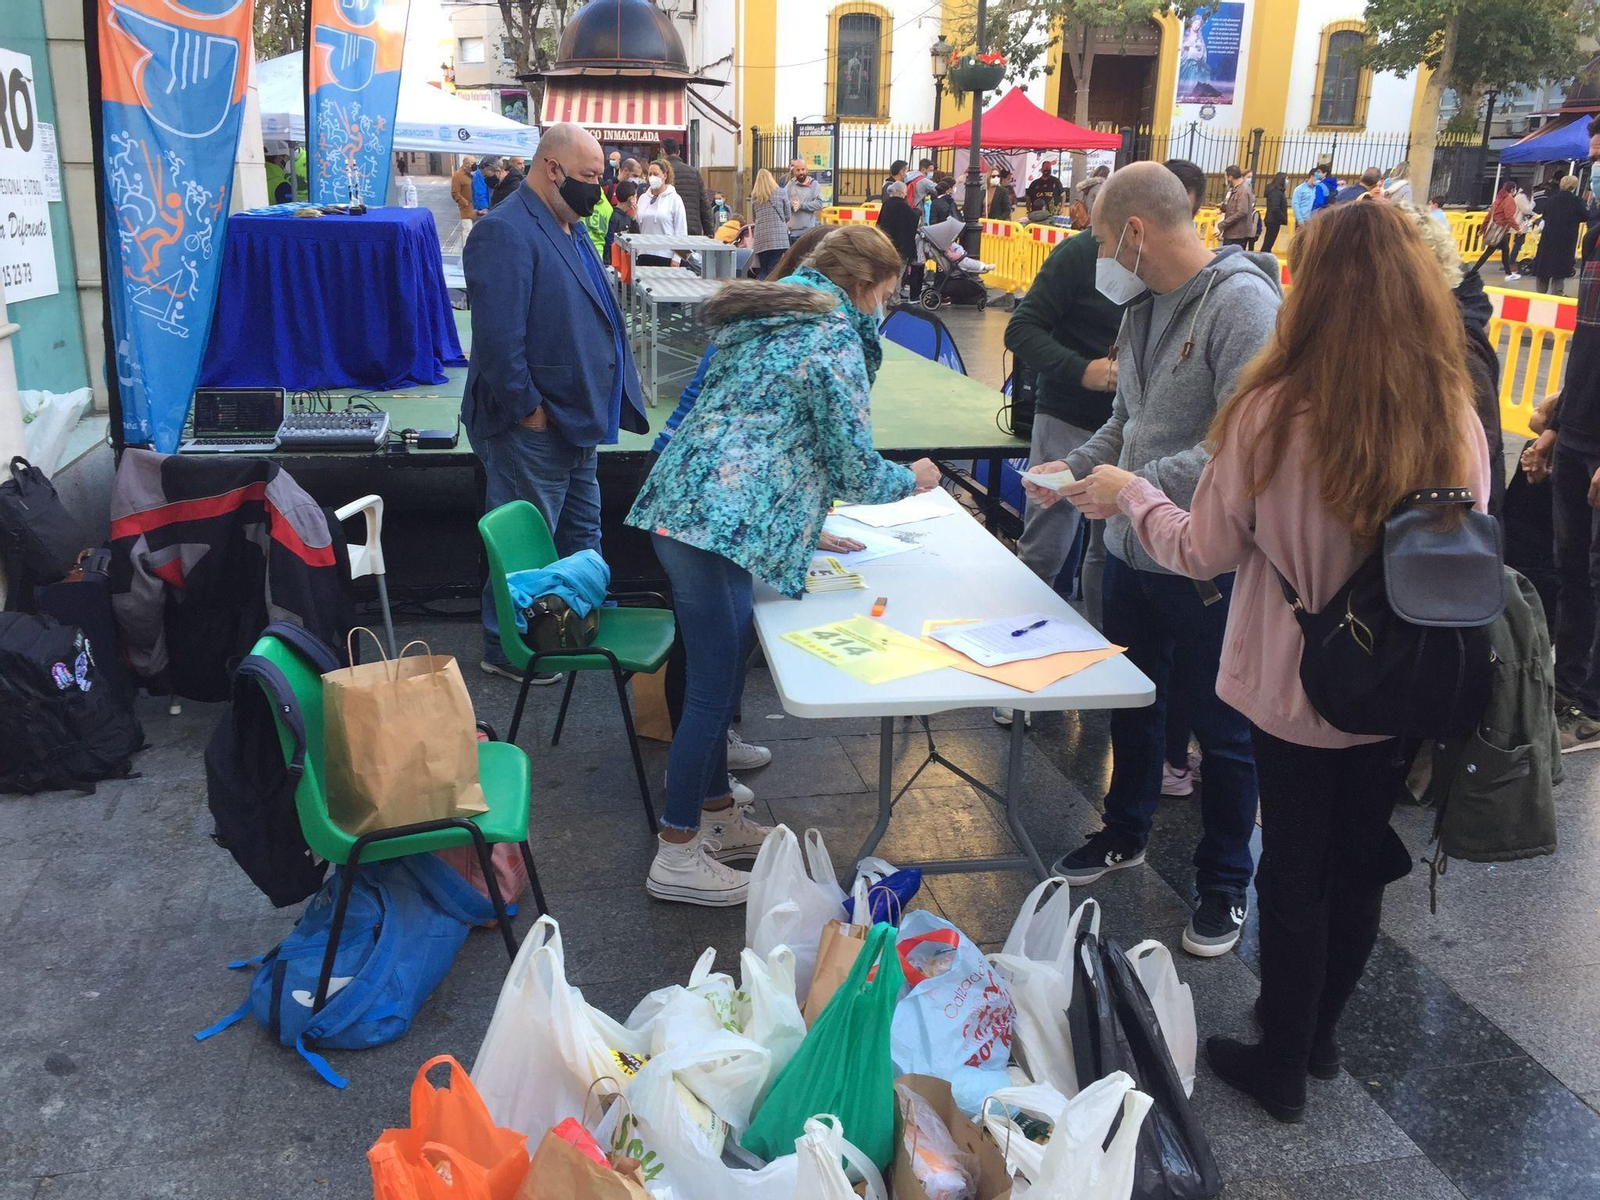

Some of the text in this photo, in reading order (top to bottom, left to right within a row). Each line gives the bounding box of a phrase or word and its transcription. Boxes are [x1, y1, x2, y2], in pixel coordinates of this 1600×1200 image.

[603, 130, 660, 142] INMACULADA
[3, 262, 32, 287] 15 23 73
[811, 631, 873, 656] 414
